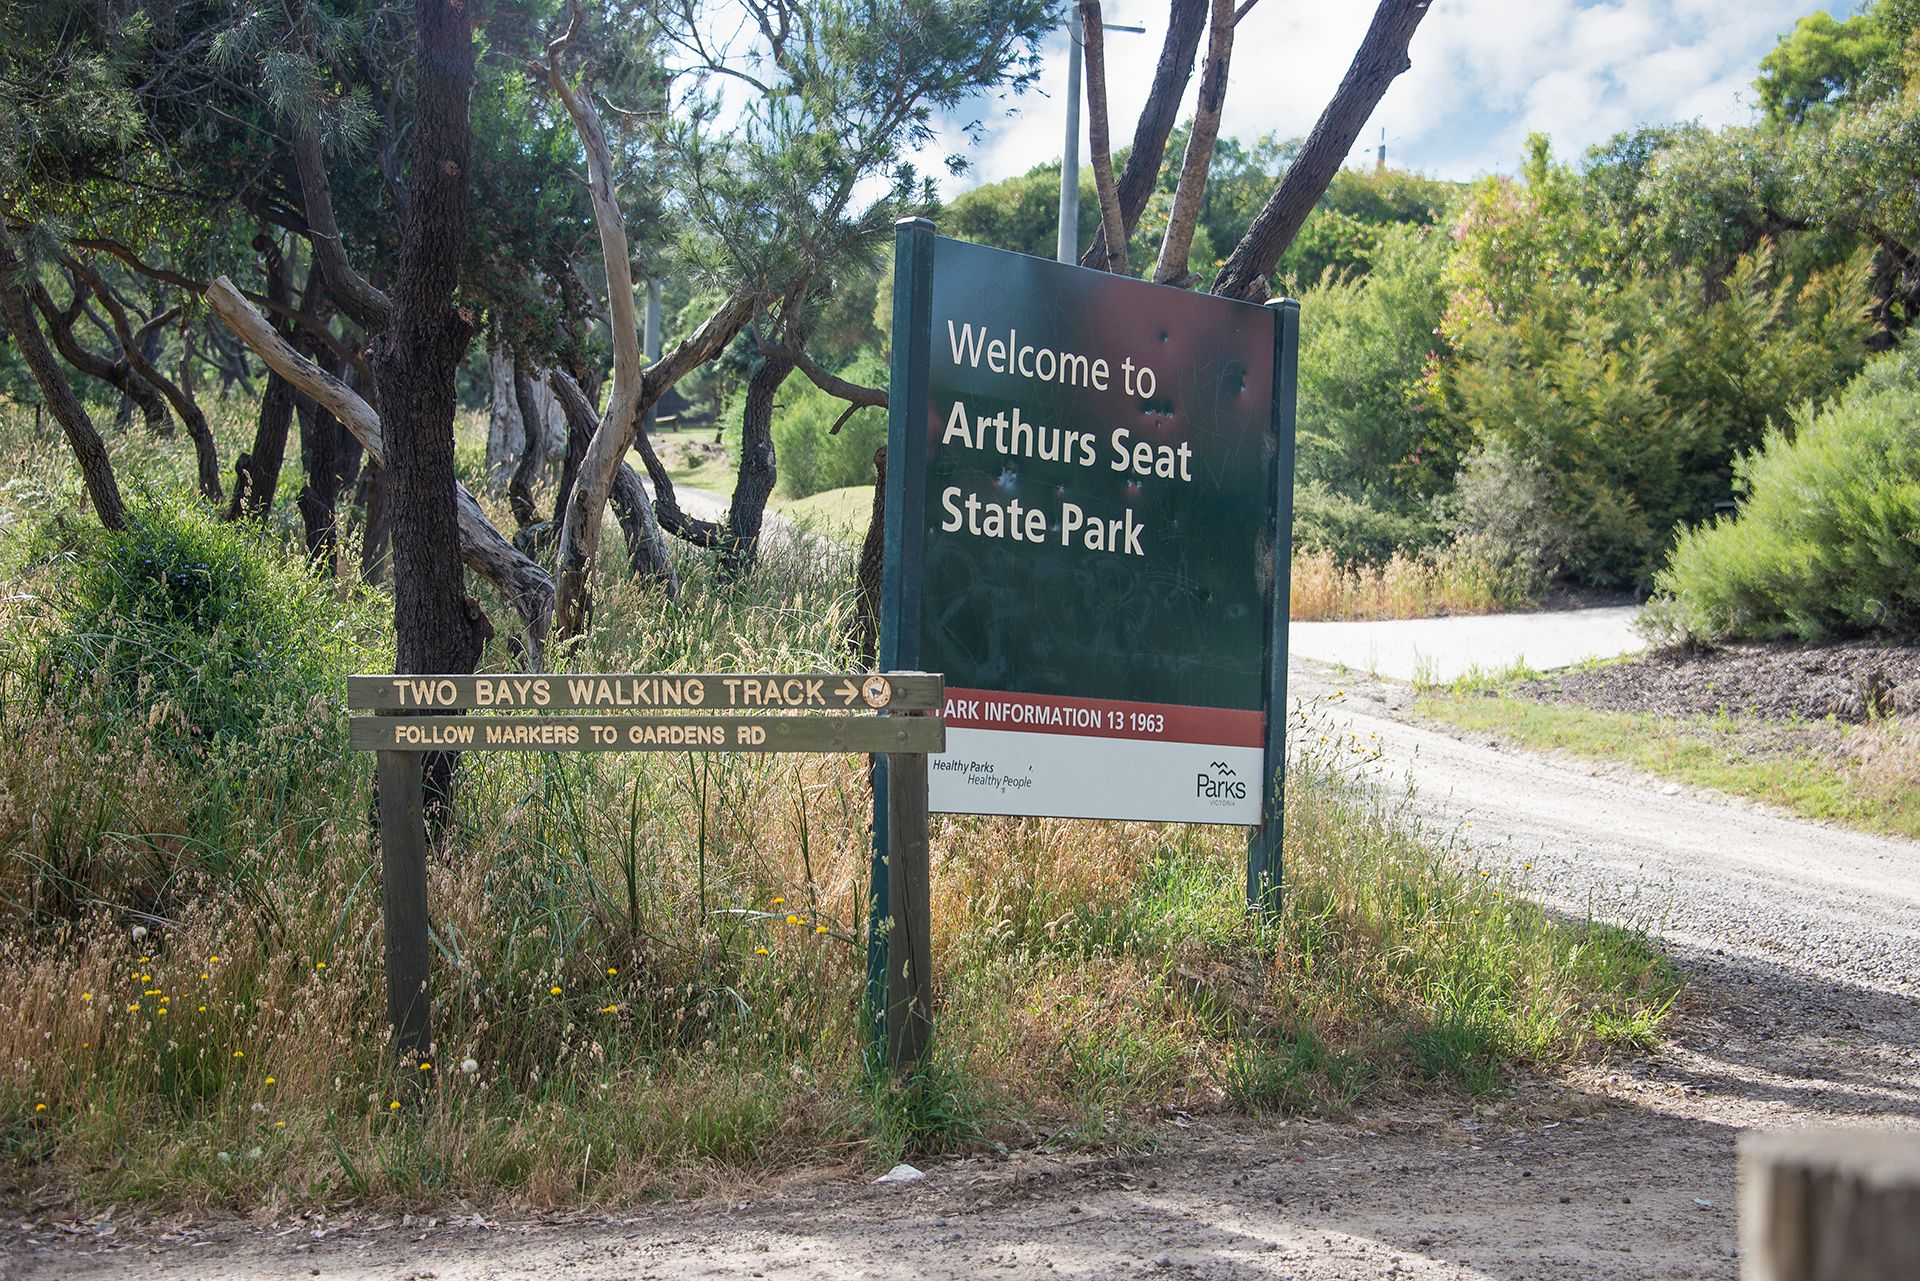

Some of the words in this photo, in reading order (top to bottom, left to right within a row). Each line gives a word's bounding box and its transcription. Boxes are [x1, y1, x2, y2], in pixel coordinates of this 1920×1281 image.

[948, 319, 1109, 392] Welcome
[1121, 356, 1156, 399] to
[942, 400, 1097, 468] Arthurs
[1111, 427, 1192, 482] Seat
[941, 486, 1047, 544] State
[1061, 502, 1145, 557] Park
[393, 679, 457, 706] TWO
[475, 679, 551, 706] BAYS
[567, 678, 705, 706] WALKING
[722, 678, 826, 706] TRACK
[936, 699, 979, 720] ARK
[984, 702, 1102, 728] INFORMATION
[1107, 711, 1125, 731] 13
[1129, 712, 1164, 733] 1963
[395, 725, 475, 744] FOLLOW
[486, 725, 579, 744] MARKERS
[590, 725, 618, 744] TO
[628, 725, 726, 745] GARDENS
[737, 725, 766, 745] RD
[932, 758, 969, 774] Healthy
[970, 761, 995, 773] Parks
[967, 773, 1001, 789] Healthy
[1002, 775, 1032, 789] People
[1197, 773, 1246, 799] Parks
